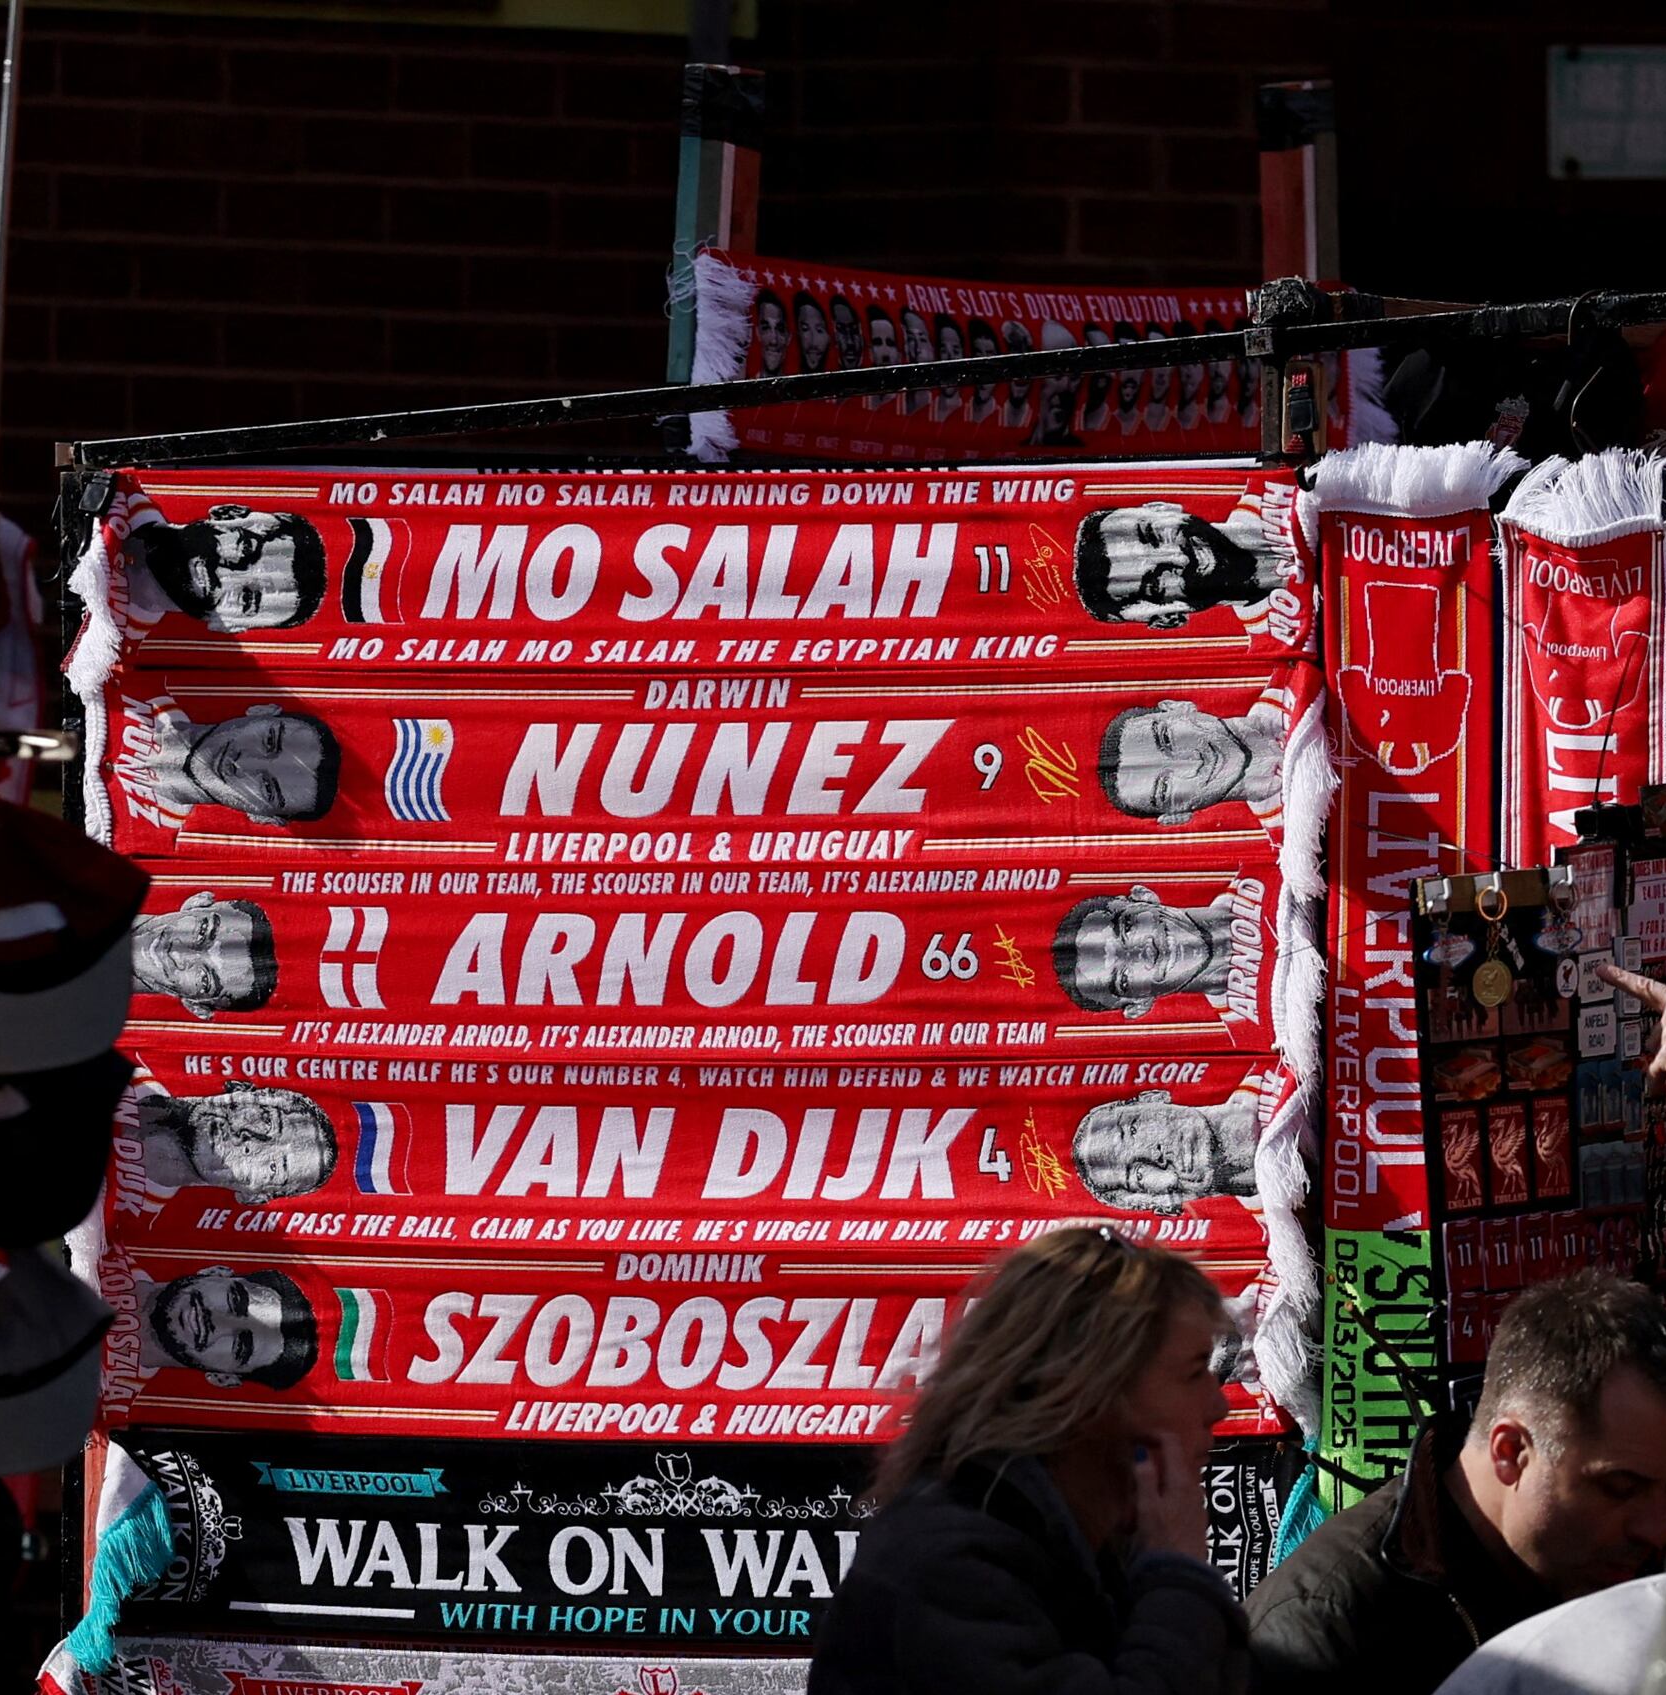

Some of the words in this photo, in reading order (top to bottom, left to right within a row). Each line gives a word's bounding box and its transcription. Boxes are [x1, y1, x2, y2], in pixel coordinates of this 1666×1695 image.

[905, 284, 955, 314] ARNE
[958, 289, 1022, 318] SLOT'S
[1023, 293, 1084, 324] DUTCH
[1085, 295, 1181, 322] EVOLUTION
[329, 483, 377, 504] MO
[389, 483, 485, 505] SALAH
[496, 485, 545, 506] MO
[556, 485, 654, 507] SALAH,
[668, 484, 809, 506] RUNNING
[822, 483, 913, 505] DOWN
[927, 482, 980, 504] THE
[993, 479, 1075, 502] WING
[1340, 522, 1470, 568] LIVERPOOL
[420, 524, 601, 621] MO
[618, 523, 958, 622] SALAH
[975, 547, 1009, 591] 11
[1525, 558, 1645, 598] LIVERPOOL
[328, 638, 383, 660] MO
[395, 639, 507, 661] SALAH
[517, 640, 572, 662] MO
[584, 640, 698, 662] SALAH,
[717, 640, 779, 662] THE
[790, 638, 959, 661] EGYPTIAN
[971, 635, 1058, 659] KING
[644, 679, 790, 709] DARWIN
[1374, 678, 1434, 696] LIVERPOOL
[500, 719, 955, 818] NUNEZ
[974, 744, 1002, 789] 9
[505, 832, 692, 862] LIVERPOOL
[709, 832, 731, 862] &
[749, 830, 914, 861] URUGUAY
[283, 872, 316, 893] THE
[321, 872, 404, 894] SCOUSER
[410, 873, 432, 893] IN
[439, 873, 479, 894] OUR
[487, 873, 541, 899] TEAM,
[552, 873, 586, 894] THE
[592, 873, 675, 894] SCOUSER
[681, 872, 703, 893] IN
[710, 872, 750, 893] OUR
[758, 872, 813, 897] TEAM,
[822, 871, 860, 893] IT'S
[865, 870, 977, 892] ALEXANDER
[981, 869, 1060, 891] ARNOLD
[430, 911, 906, 1007] ARNOLD
[922, 934, 978, 979] 66
[1225, 877, 1266, 1024] ARNOLD
[1584, 1013, 1608, 1028] ANFIELD
[1589, 1033, 1605, 1048] ROAD
[185, 1056, 232, 1075] HE'S
[242, 1056, 287, 1077] OUR
[297, 1059, 378, 1080] CENTRE
[388, 1062, 441, 1082] HALF
[451, 1064, 498, 1083] HE'S
[509, 1065, 553, 1084] OUR
[564, 1066, 658, 1085] NUMBER
[668, 1067, 685, 1088] 4,
[700, 1068, 773, 1087] WATCH
[784, 1068, 827, 1087] HIM
[838, 1068, 921, 1087] DEFEND
[931, 1068, 945, 1087] &
[958, 1067, 989, 1087] WE
[1000, 1065, 1075, 1086] WATCH
[1082, 1064, 1129, 1084] HIM
[1134, 1063, 1209, 1083] SCORE
[1333, 986, 1361, 1220] LIVERPOOL
[445, 1105, 675, 1198] VAN
[701, 1108, 977, 1201] DIJK
[979, 1129, 1011, 1181] 4
[197, 1209, 231, 1229] HE
[235, 1211, 283, 1231] CAN
[286, 1213, 346, 1235] PASS
[351, 1215, 396, 1236] THE
[399, 1216, 457, 1240] BALL,
[471, 1217, 534, 1239] CALM
[536, 1219, 571, 1240] AS
[577, 1220, 625, 1241] YOU
[627, 1220, 682, 1242] LIKE,
[693, 1221, 748, 1241] HE'S
[753, 1221, 831, 1241] VIRGIL
[839, 1221, 888, 1240] VAN
[891, 1221, 949, 1241] DIJK,
[958, 1220, 1014, 1240] HE'S
[1155, 1220, 1210, 1241] DIJK
[616, 1254, 766, 1282] DOMINIK
[404, 1290, 983, 1391] SZOBOSZLA
[505, 1401, 683, 1433] LIVERPOOL
[690, 1404, 717, 1434] &
[724, 1405, 892, 1435] HUNGARY
[289, 1472, 422, 1493] LIVERPOOL
[284, 1518, 522, 1592] WALK
[549, 1526, 664, 1596] ON
[440, 1603, 536, 1630] WITH
[550, 1606, 646, 1632] HOPE
[660, 1608, 695, 1633] IN
[709, 1609, 809, 1635] YOUR
